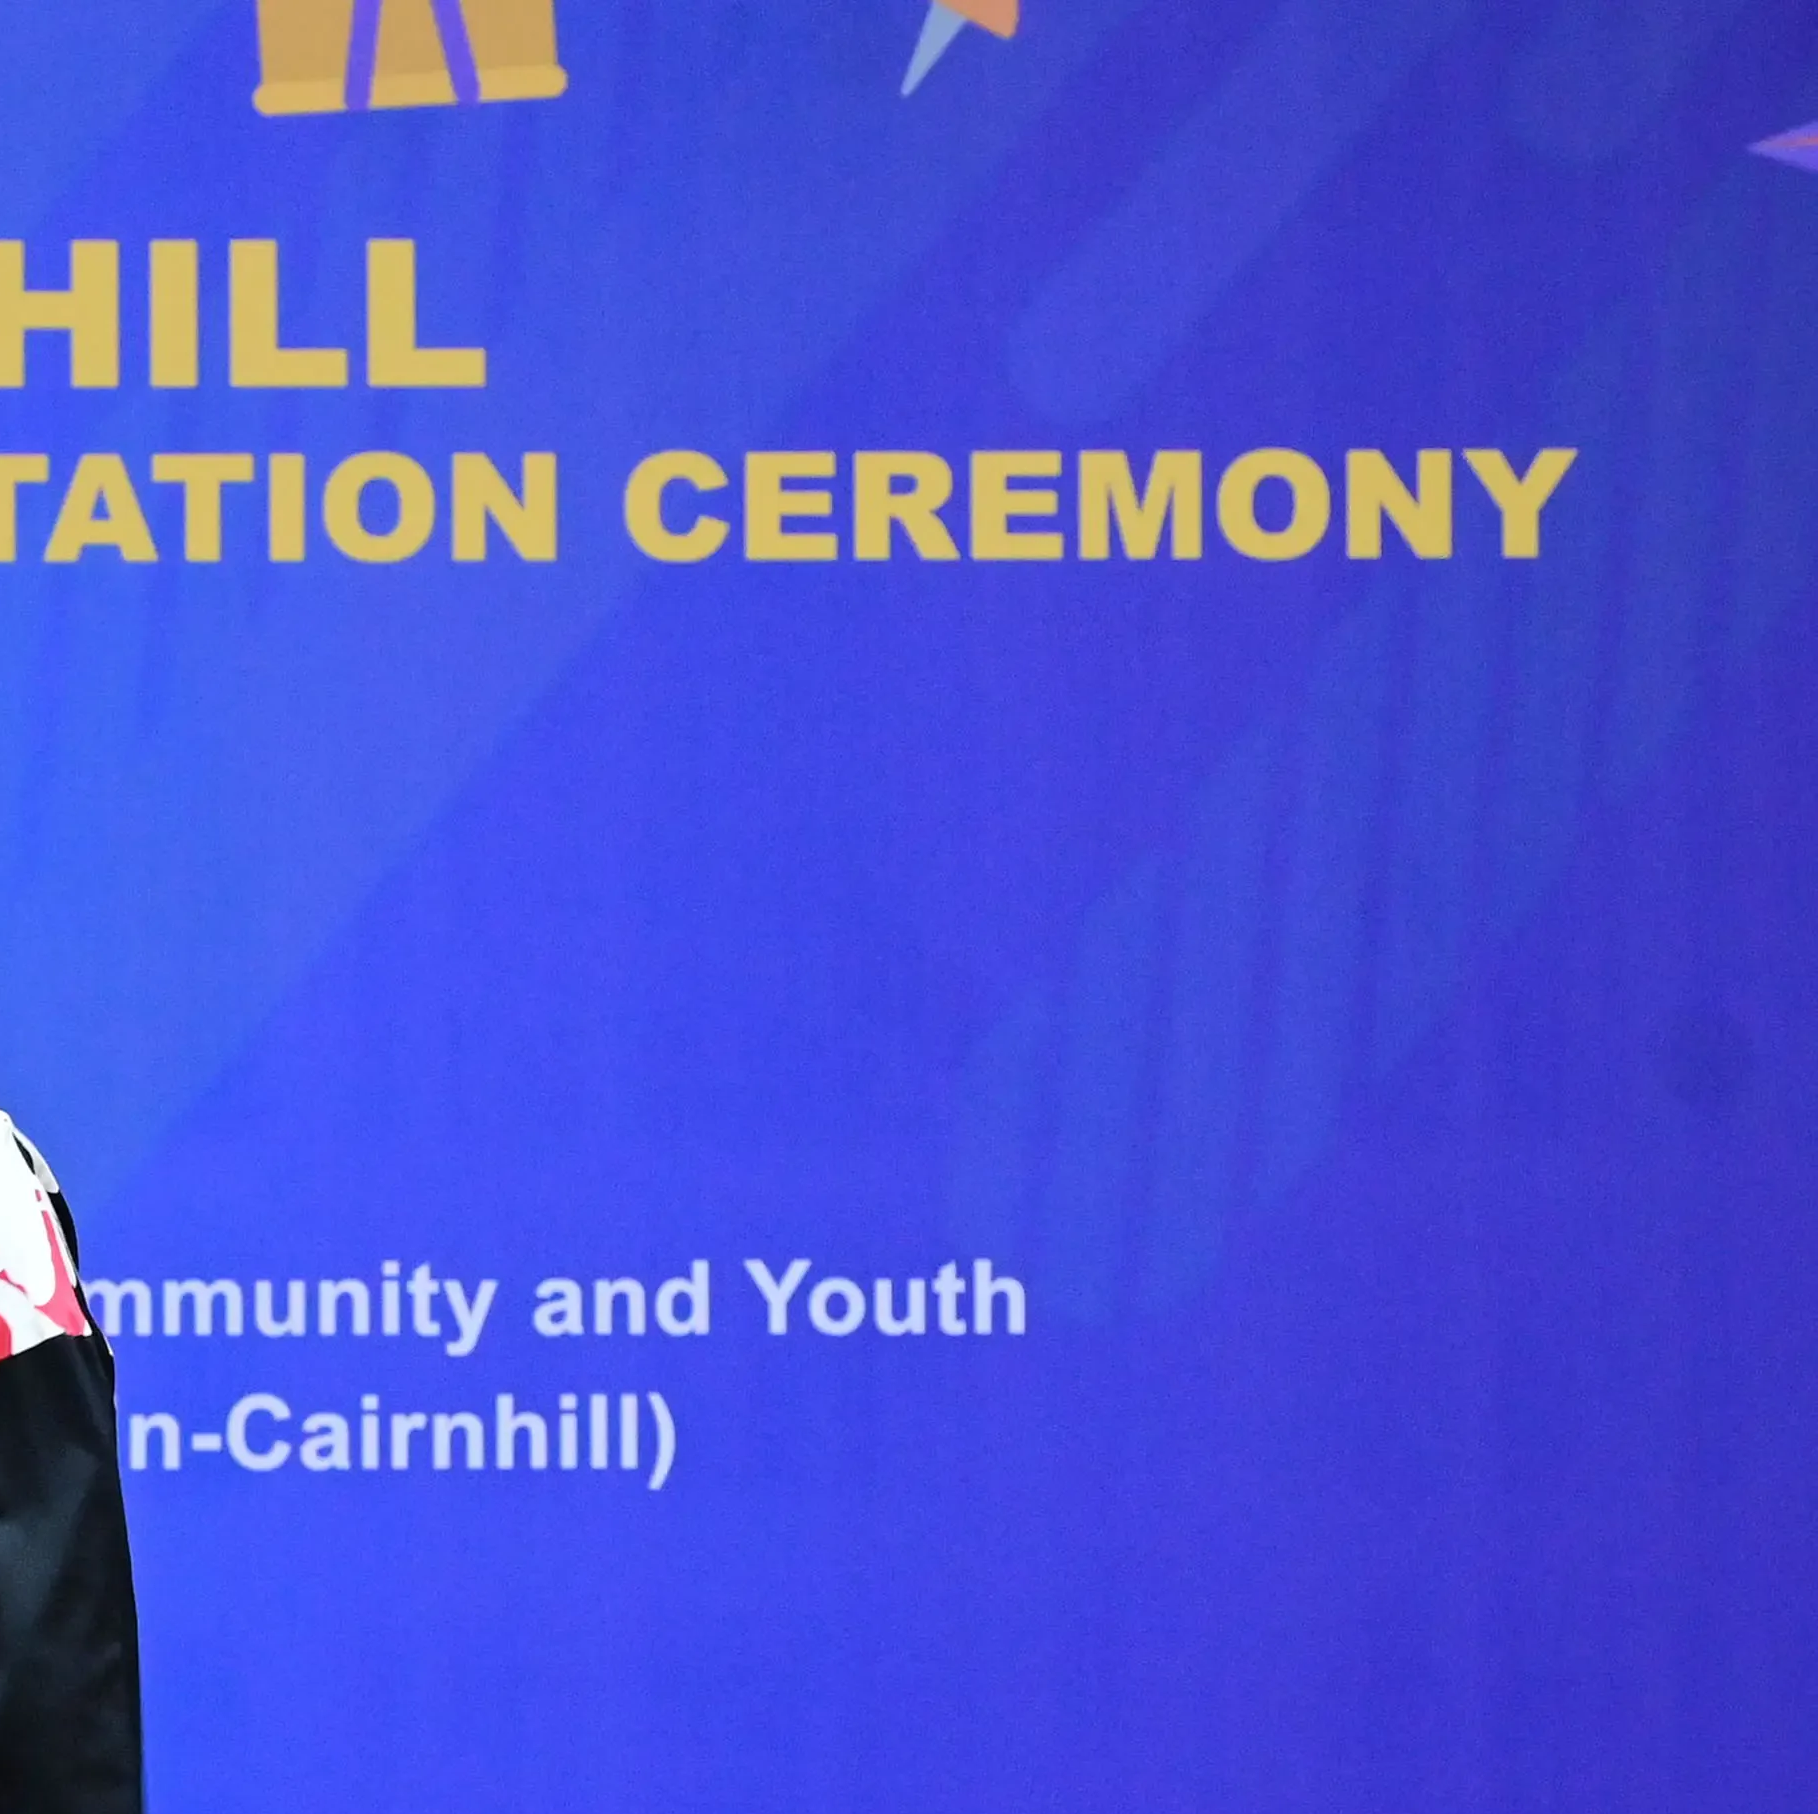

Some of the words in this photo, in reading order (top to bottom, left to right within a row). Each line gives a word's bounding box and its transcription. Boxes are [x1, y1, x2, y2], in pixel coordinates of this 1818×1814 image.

[623, 448, 1579, 563] CEREMONY
[83, 1259, 498, 1357] mmunity
[532, 1259, 710, 1337] and
[745, 1258, 1026, 1336] Youth
[128, 1392, 677, 1490] n-Cairnhill)
